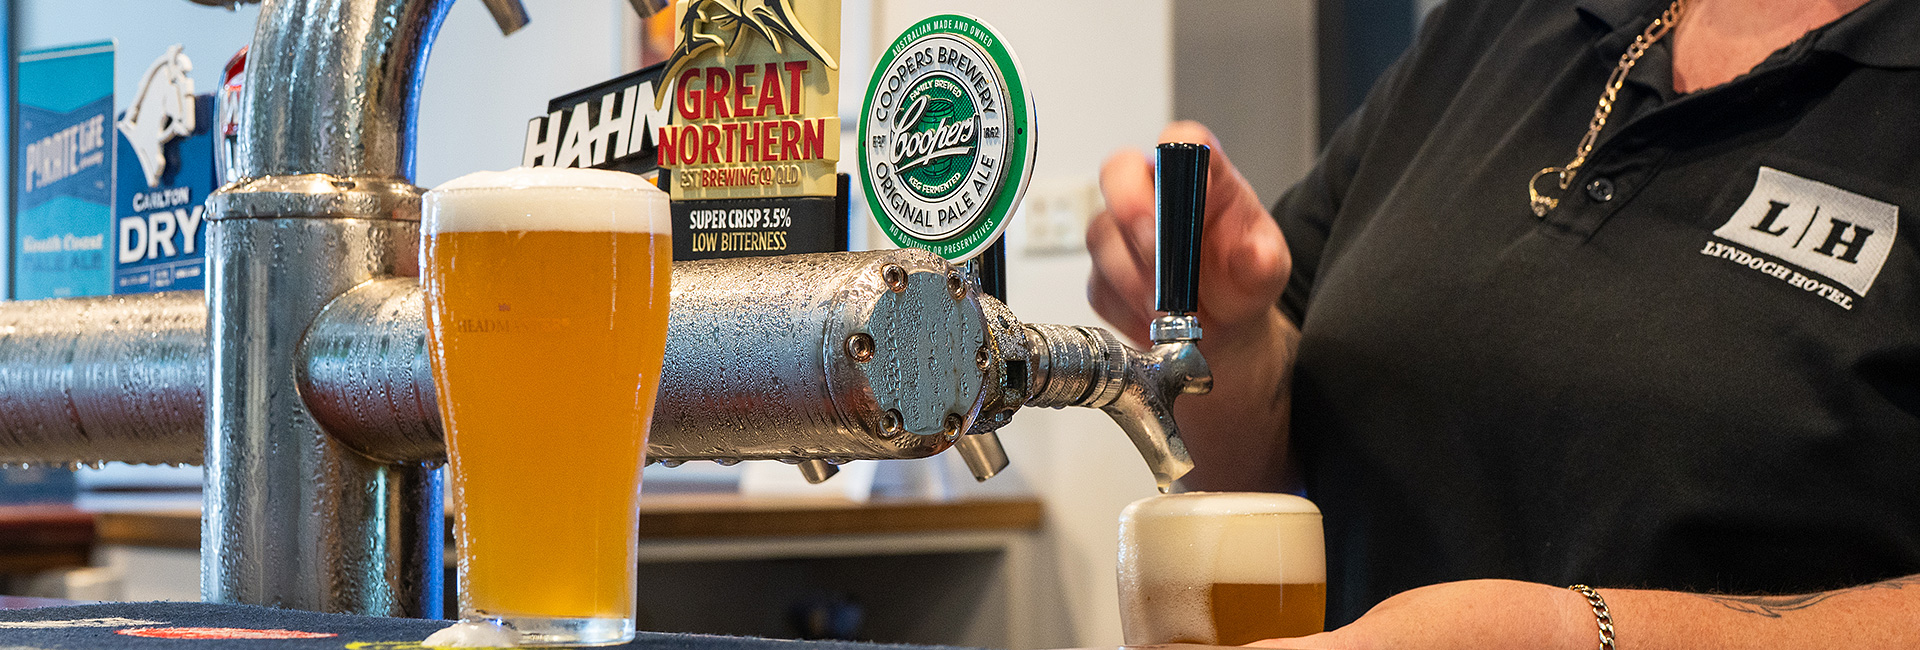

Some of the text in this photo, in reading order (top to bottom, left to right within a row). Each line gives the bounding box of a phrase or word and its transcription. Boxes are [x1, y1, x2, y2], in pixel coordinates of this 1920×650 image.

[892, 19, 993, 57] AUSTRALIAN MADE AND OWNED
[676, 59, 809, 121] GREAT
[876, 46, 997, 122] COOPERS BREWERY
[909, 79, 962, 102] FAMILY BREWED
[522, 78, 675, 169] HAHN
[656, 118, 826, 167] NORTHERN
[890, 94, 980, 166] Coopers
[701, 166, 759, 188] BREWING
[775, 164, 800, 185] QLD
[876, 154, 995, 228] ORIGINAL PALE ALE
[908, 172, 962, 194] KEG FERMENTED
[132, 186, 190, 213] CARLTON
[689, 207, 792, 230] SUPER CRISP 3.5%
[118, 205, 204, 264] DRY
[692, 231, 788, 252] LOW BITTERNESS
[889, 217, 994, 255] NO ADDITIVES OR PRESERVATIVES
[1700, 240, 1853, 311] LYNDOCH HOTEL
[458, 318, 562, 333] HEADM
